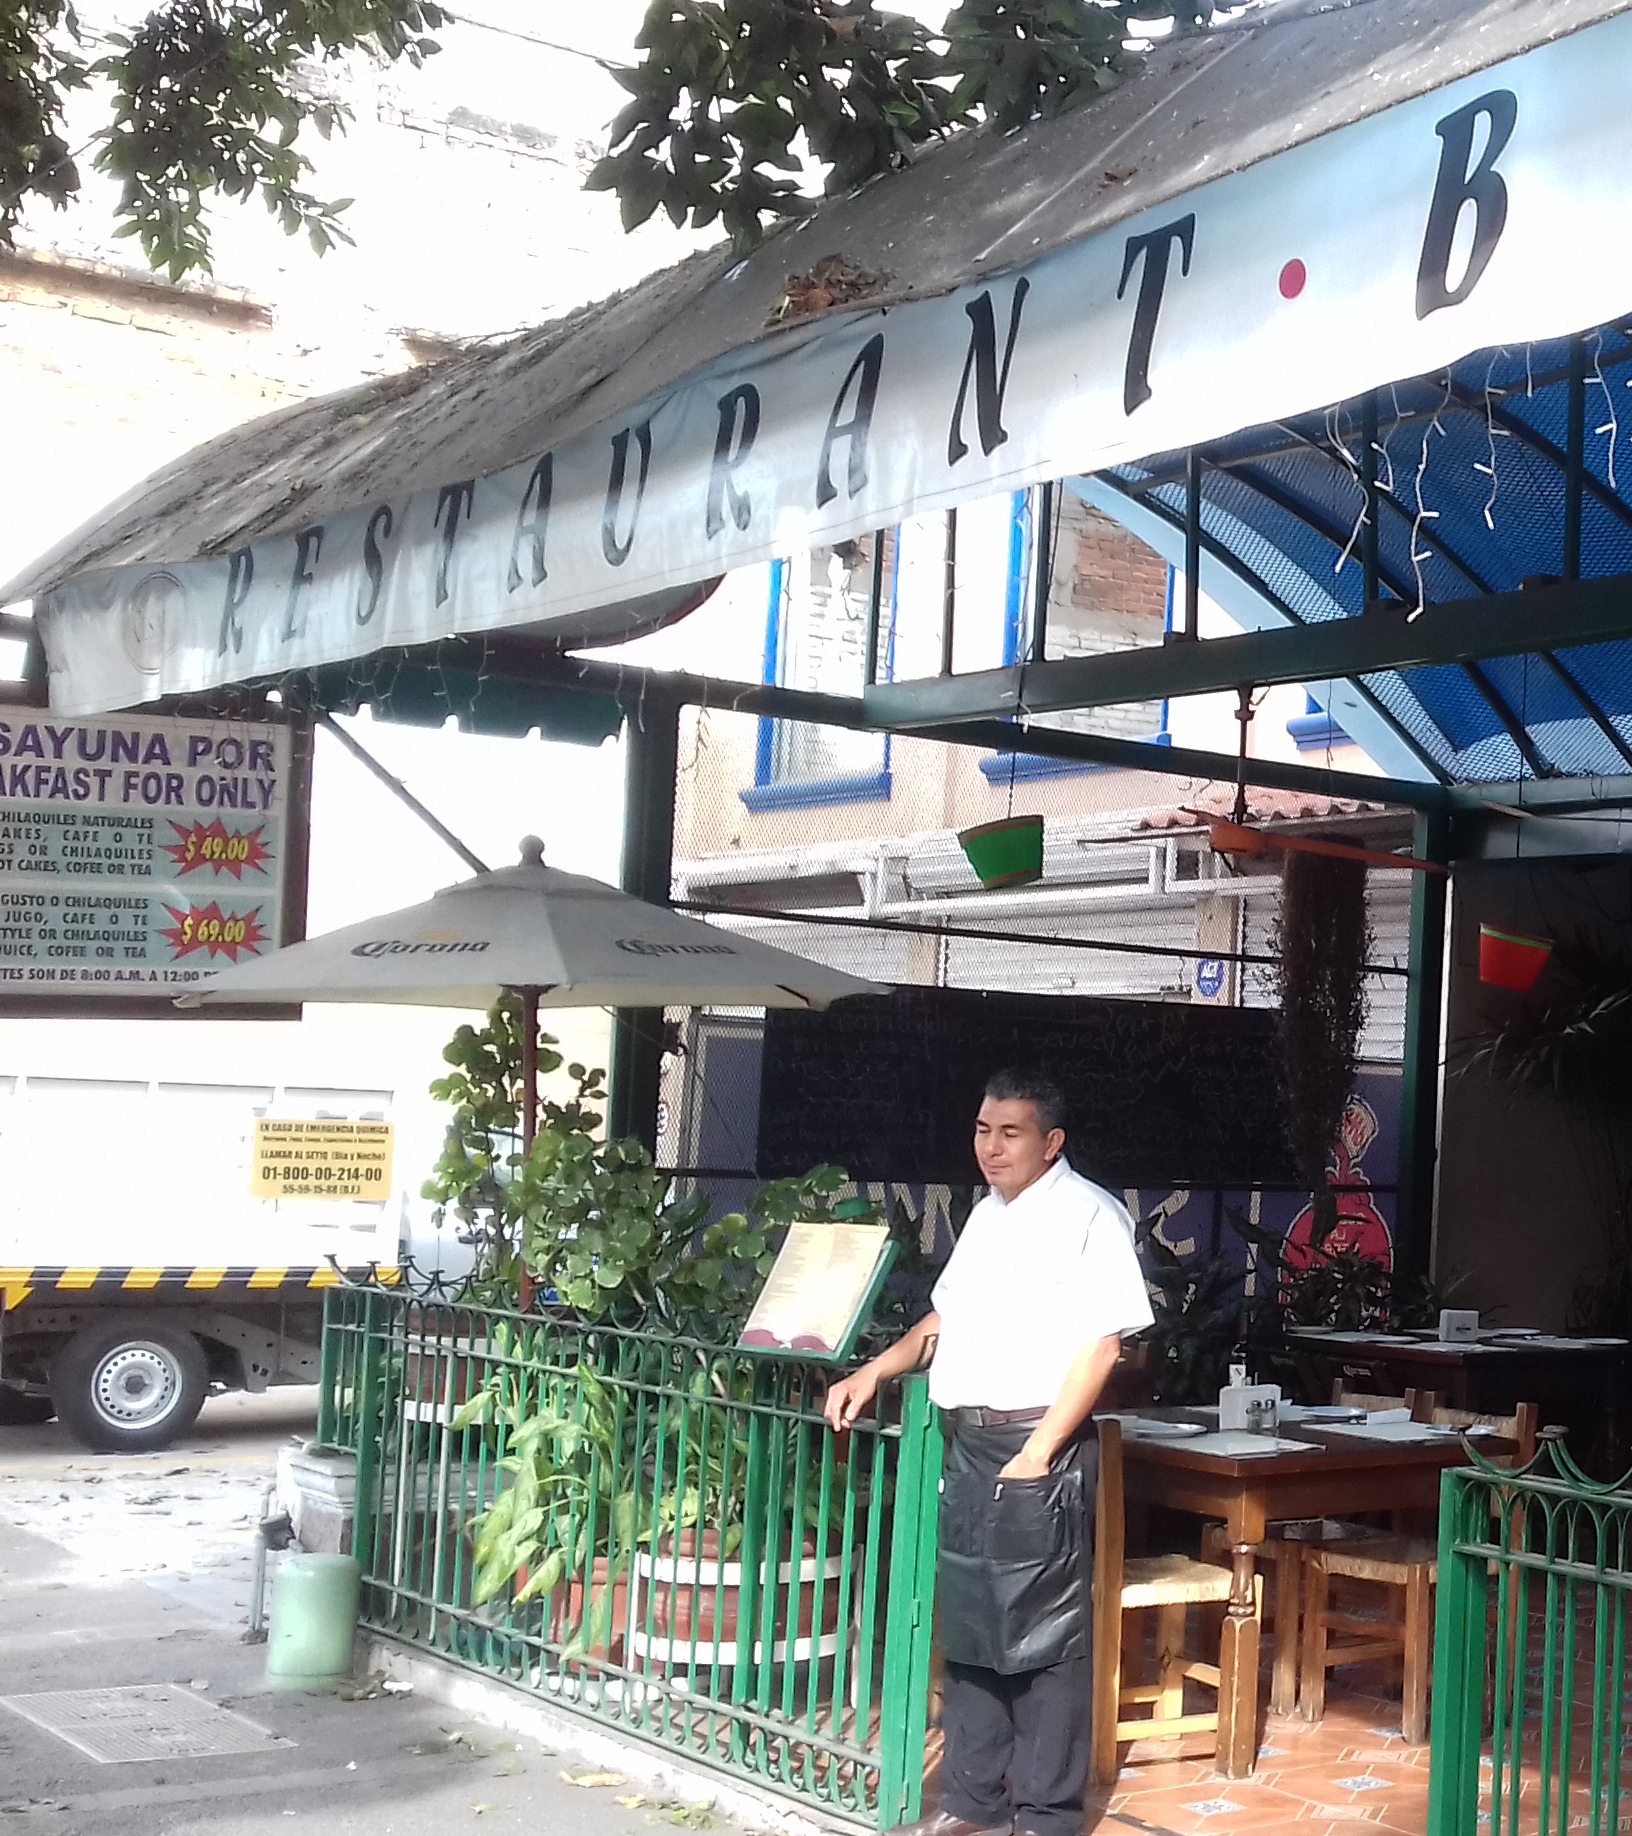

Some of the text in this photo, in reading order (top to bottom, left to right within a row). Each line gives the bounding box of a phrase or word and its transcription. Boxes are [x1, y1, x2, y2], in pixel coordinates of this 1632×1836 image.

[219, 212, 1197, 657] RESTAURANT
[188, 735, 276, 773] POR
[122, 770, 184, 805] FOR
[195, 774, 277, 810] ONLY
[0, 812, 154, 828] HILAQUILES NATURALES
[114, 832, 122, 843] O
[28, 844, 48, 856] OR
[61, 845, 153, 860] CHILAQUILES
[185, 832, 249, 861] $ 49.00
[18, 859, 61, 874] CAKES,
[107, 863, 125, 874] OR
[130, 864, 151, 875] TEA
[1, 894, 149, 909] GUSTO O CHILAQUILES
[4, 911, 48, 926] JUGO,
[110, 914, 119, 926] O
[132, 914, 148, 926] TE
[39, 929, 57, 940] OR
[64, 929, 147, 942] CHILAQUILES
[182, 915, 246, 944] $ 69.00
[0, 944, 37, 958] UICE,
[96, 946, 114, 958] OR
[124, 946, 147, 958] TEA
[350, 939, 491, 959] Corona
[615, 939, 739, 957] Corona
[59, 969, 76, 980] DE
[80, 969, 111, 980] 8:00
[149, 970, 158, 982] A
[163, 970, 199, 982] 12:00
[262, 1165, 382, 1181] 01-800-00-214-00
